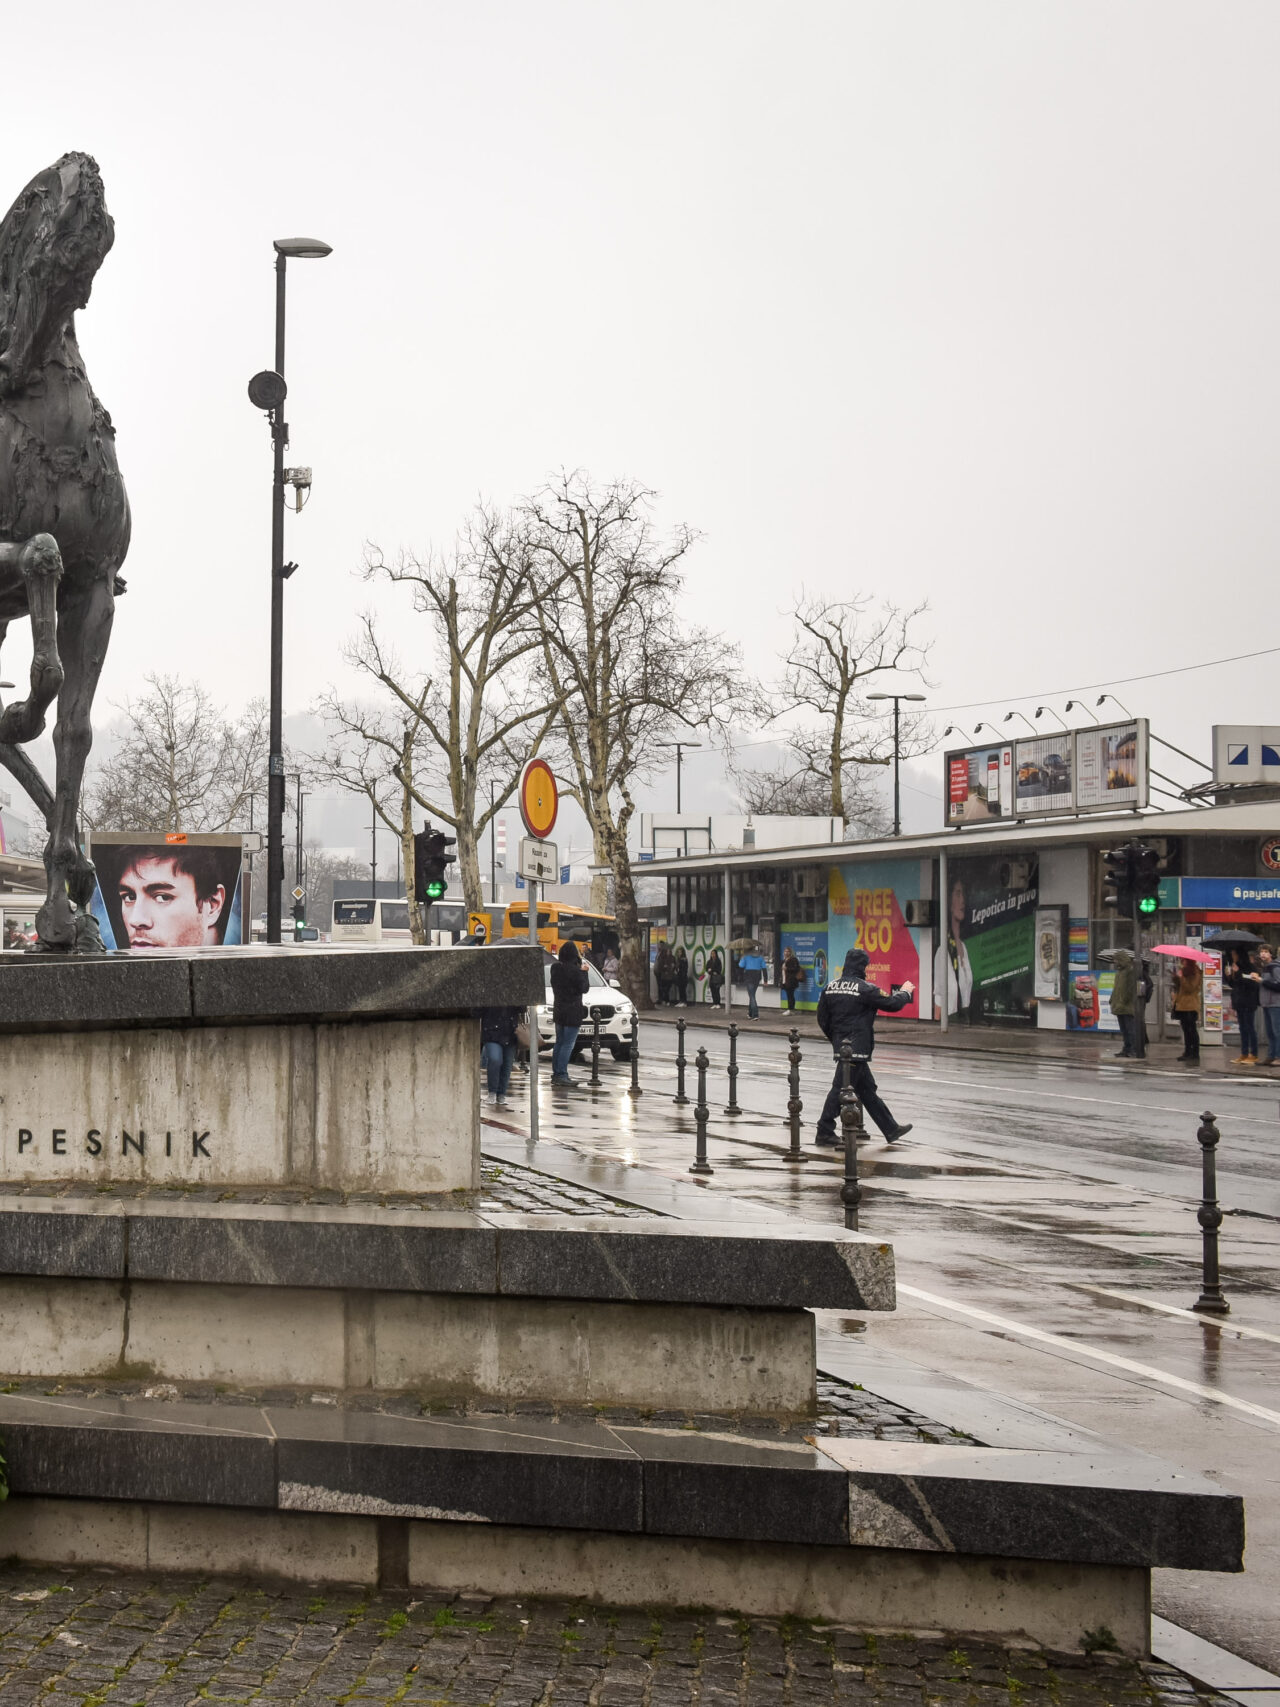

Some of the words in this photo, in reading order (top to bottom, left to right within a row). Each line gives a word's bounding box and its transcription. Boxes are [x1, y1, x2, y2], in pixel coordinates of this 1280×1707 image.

[853, 888, 893, 916] FREE
[971, 899, 1006, 924] Lepotica
[1007, 893, 1017, 910] in
[1016, 888, 1037, 911] pivo
[854, 918, 893, 953] 2GO
[827, 981, 859, 992] POLICIJA
[18, 1128, 211, 1158] PESNIK
